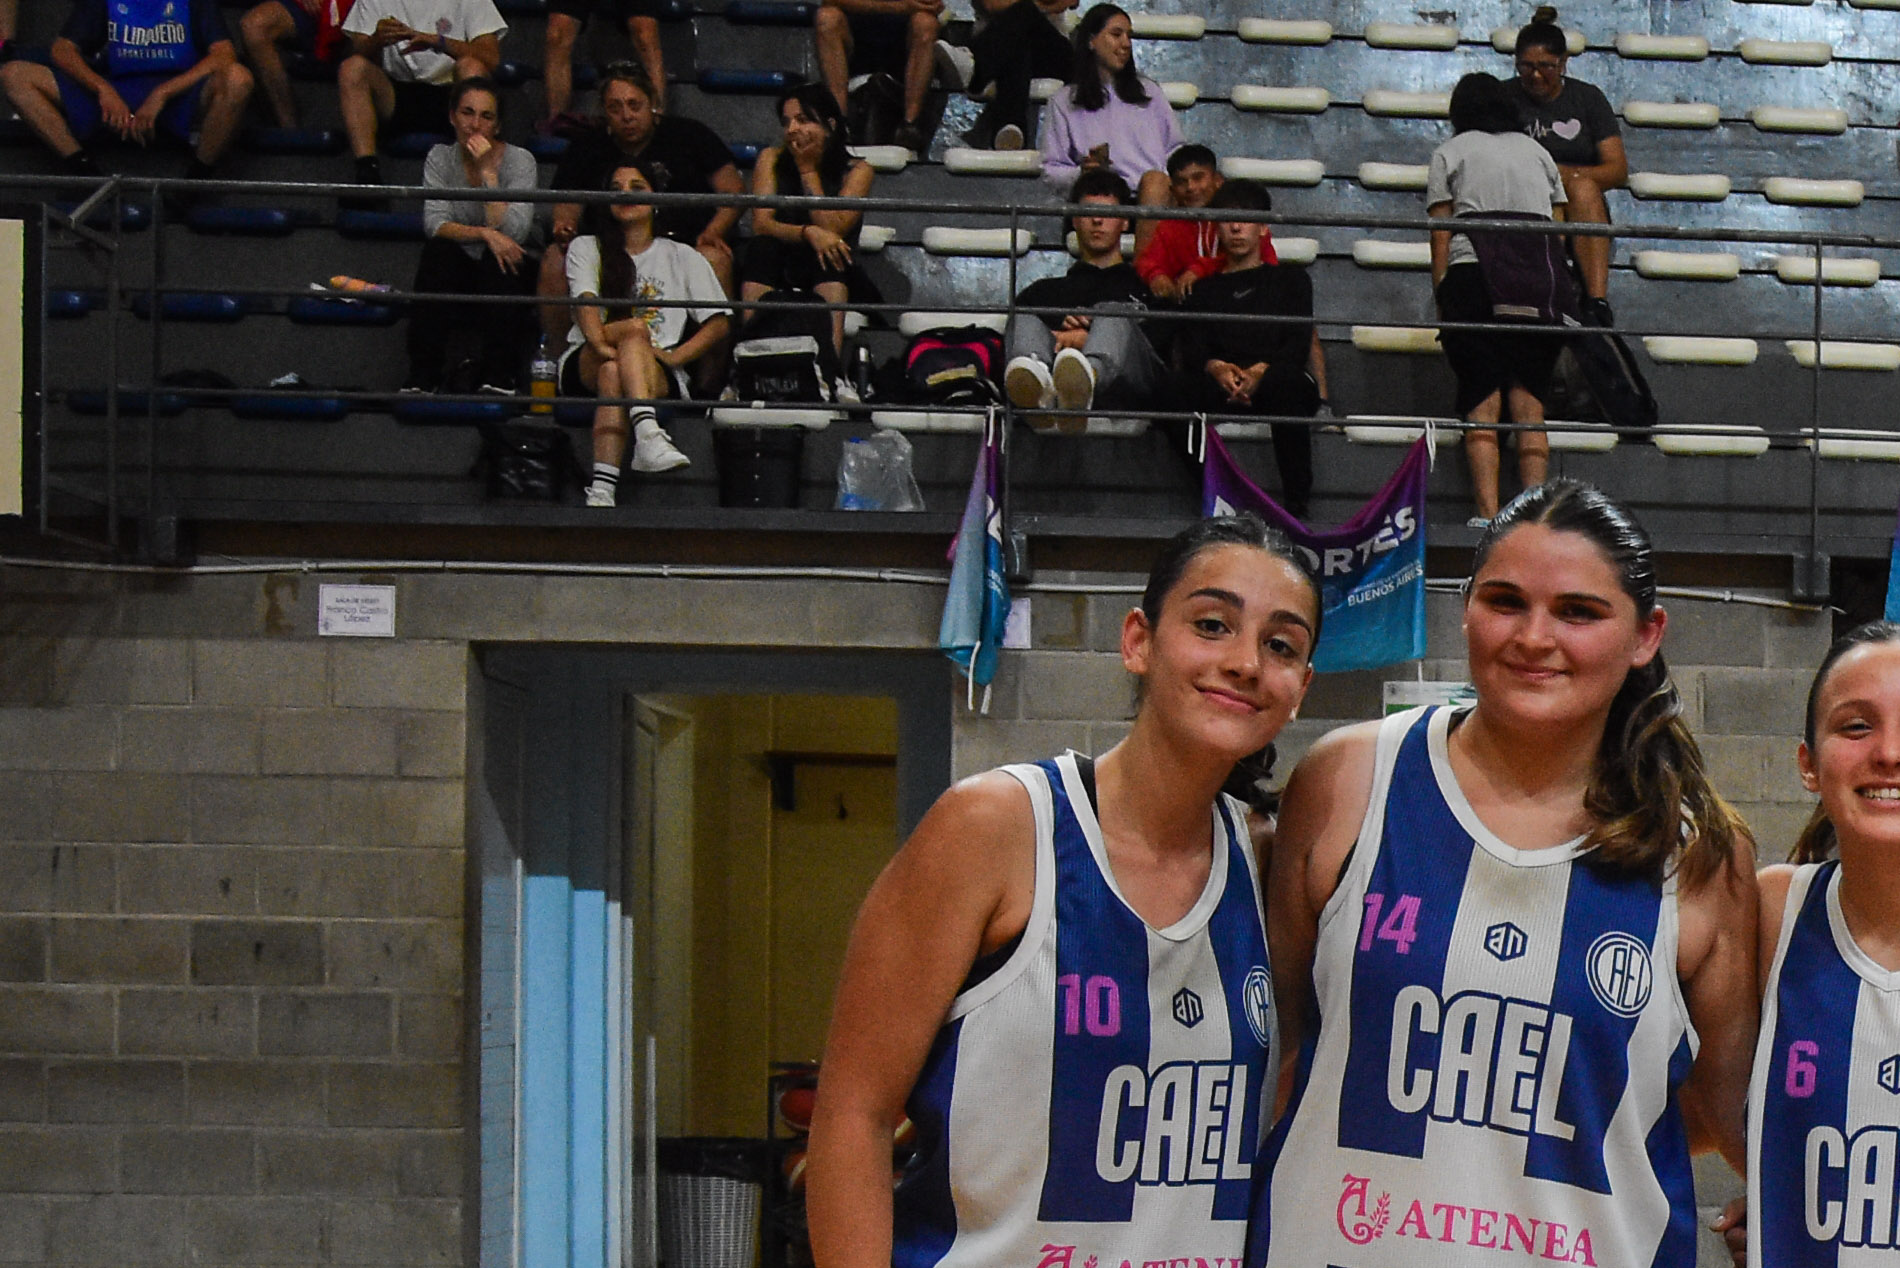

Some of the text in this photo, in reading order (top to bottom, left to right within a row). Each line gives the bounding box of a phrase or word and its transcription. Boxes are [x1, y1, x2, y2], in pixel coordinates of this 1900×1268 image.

[1213, 495, 1416, 576] DORTES
[1347, 581, 1395, 607] BUENOS
[1359, 893, 1421, 954] 14
[1058, 973, 1121, 1037] 10
[1387, 984, 1576, 1142] CAEL
[1784, 1040, 1820, 1098] 6
[1095, 1064, 1252, 1183] CAEL
[1395, 1199, 1598, 1268] ATENEA
